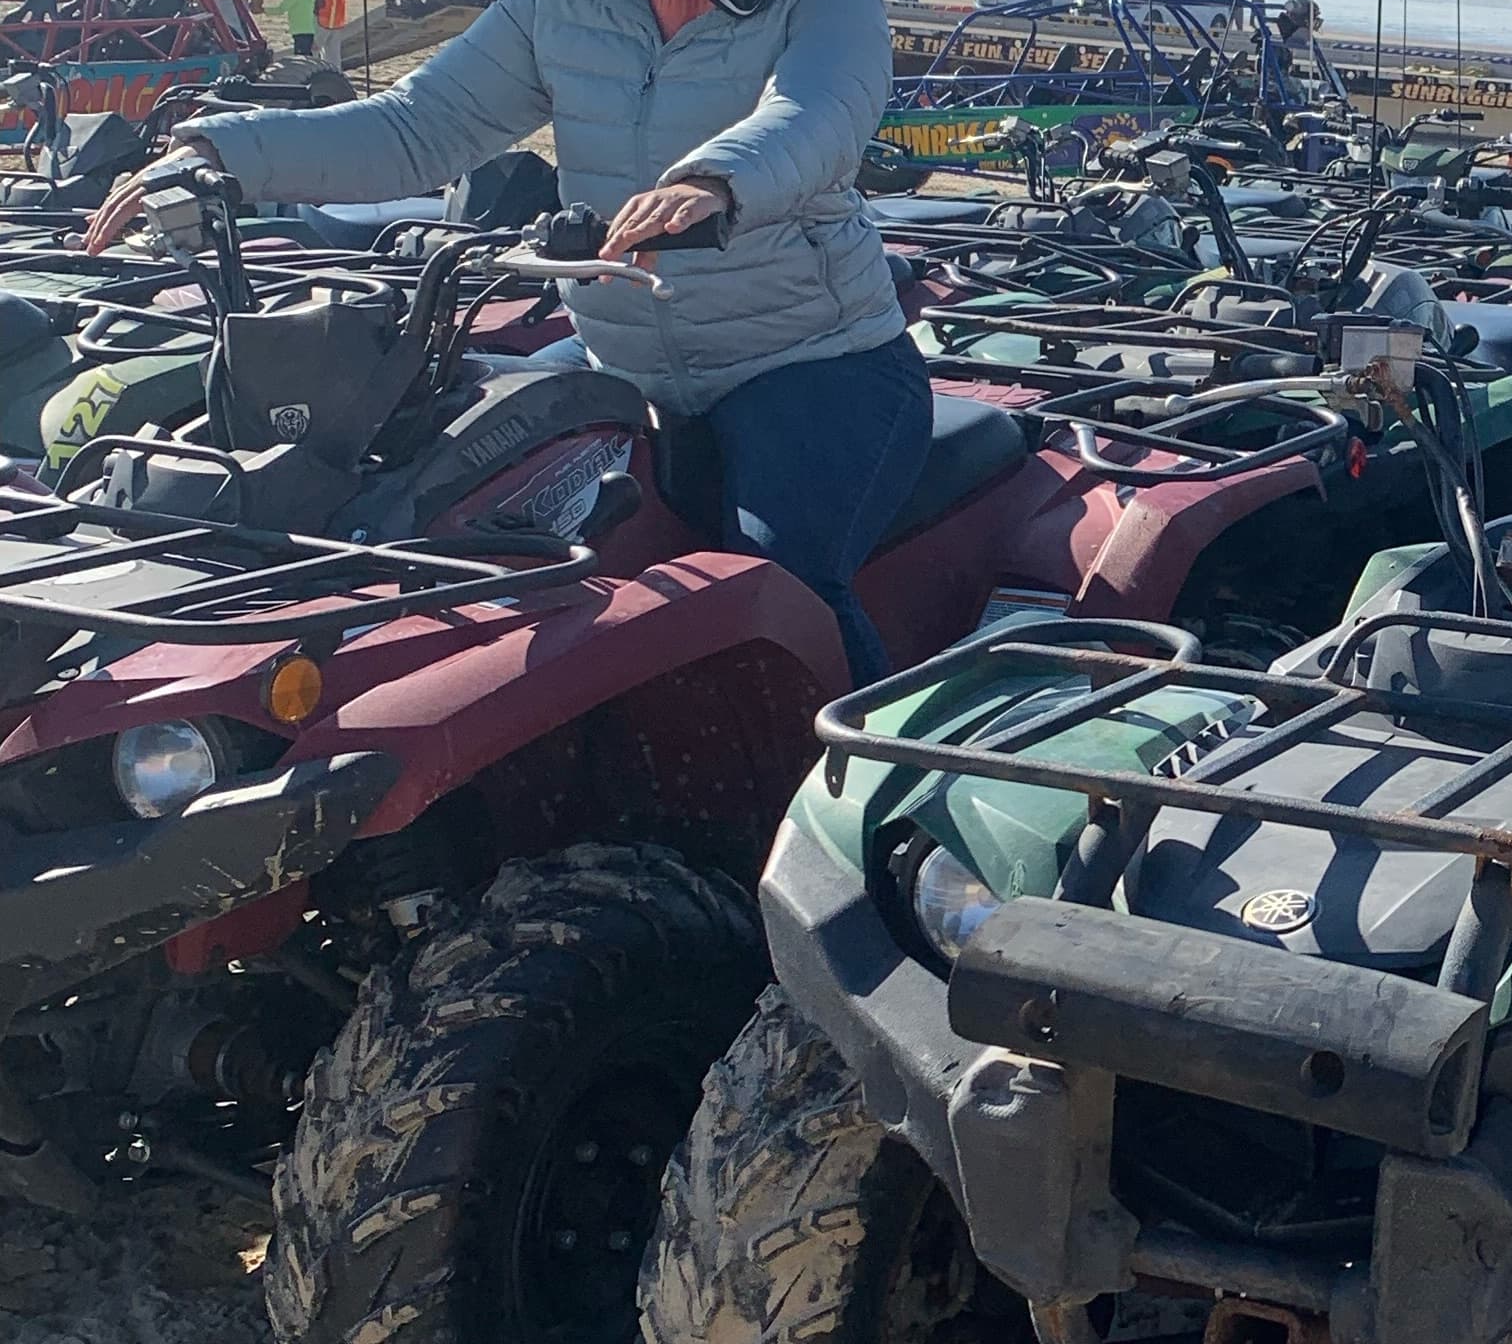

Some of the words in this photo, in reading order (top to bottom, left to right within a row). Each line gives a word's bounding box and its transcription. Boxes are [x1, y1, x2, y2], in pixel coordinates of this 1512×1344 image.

[962, 42, 1003, 60] FUN
[1008, 47, 1059, 65] NEVE
[462, 418, 530, 467] YAMAHA
[521, 434, 627, 519] KODIAK
